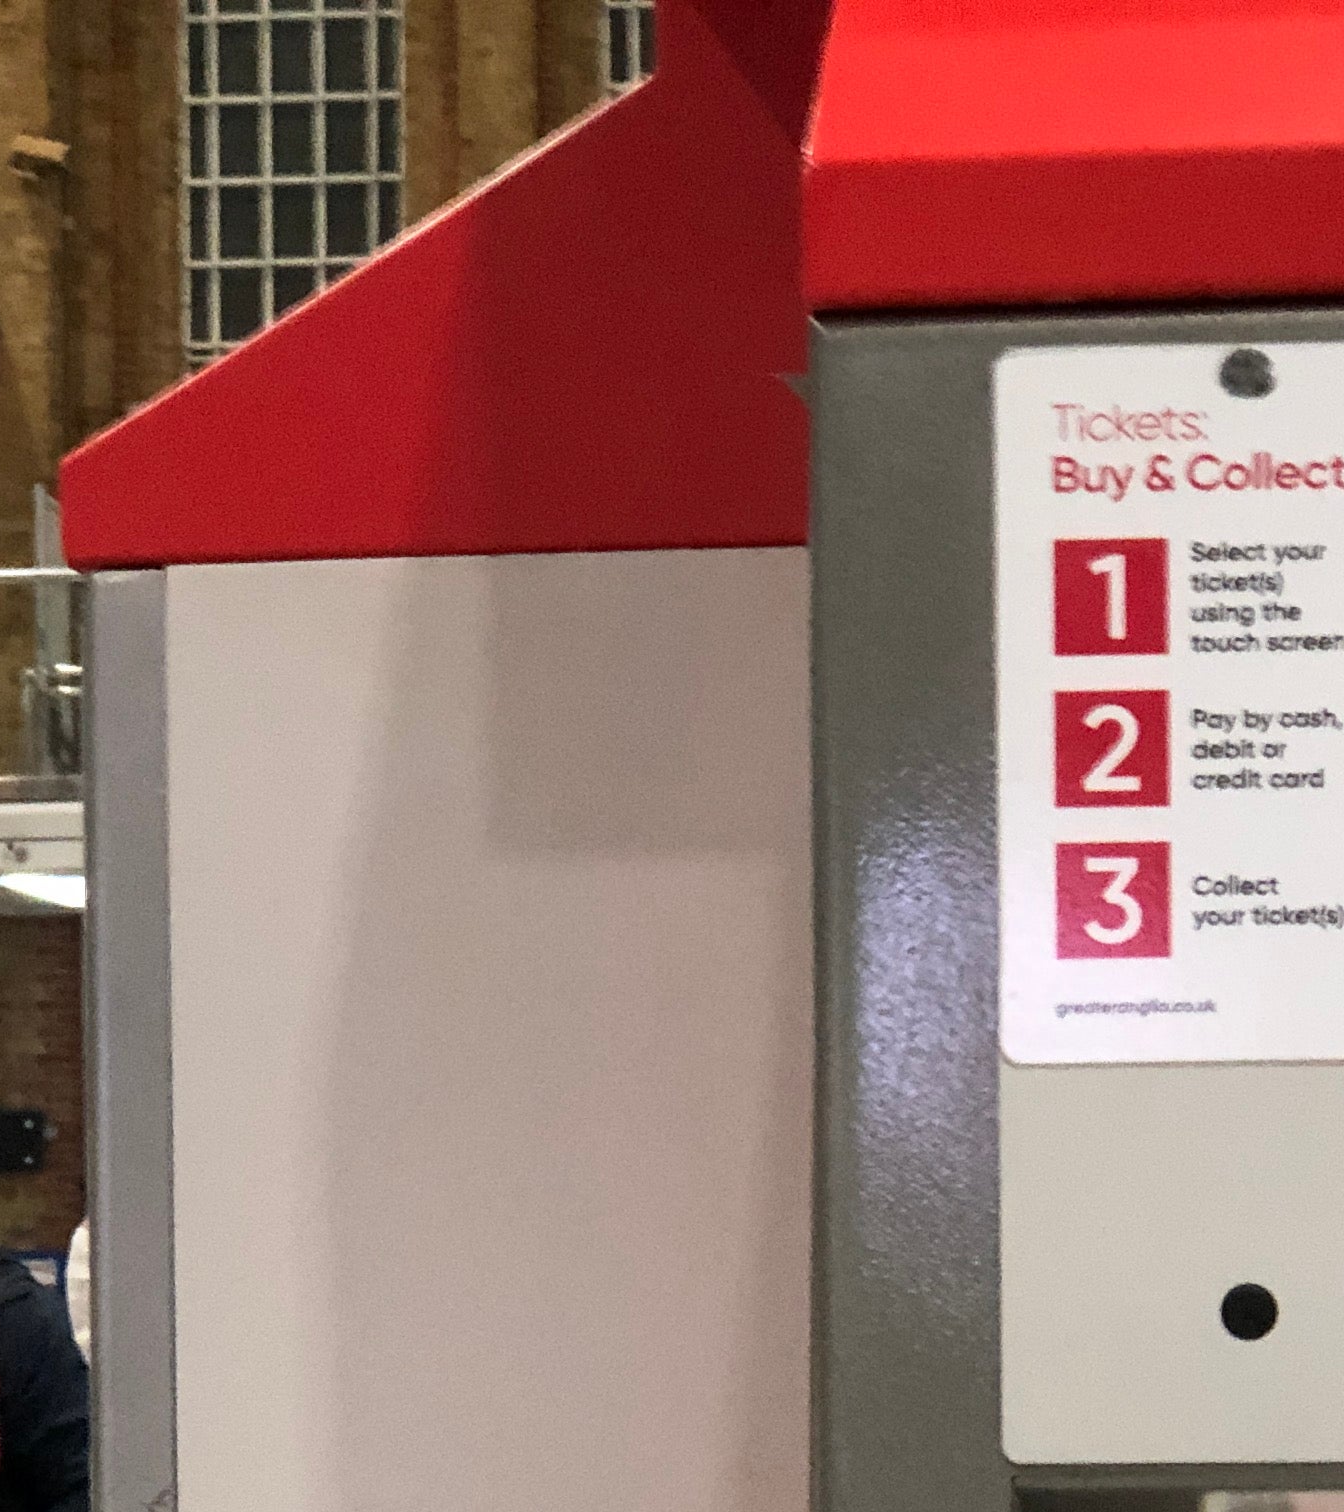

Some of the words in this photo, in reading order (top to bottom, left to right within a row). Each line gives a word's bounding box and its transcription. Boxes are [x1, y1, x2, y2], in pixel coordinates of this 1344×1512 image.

[1052, 402, 1209, 442] Tickets:
[1051, 454, 1134, 501] Buy
[1143, 453, 1176, 492] &
[1189, 541, 1266, 562] Select
[1275, 543, 1326, 565] your
[1190, 572, 1284, 596] ticket(s)
[1087, 552, 1128, 641] 1
[1190, 604, 1255, 626] using
[1261, 602, 1302, 622] the
[1190, 632, 1260, 653] touch
[1191, 709, 1235, 731] Pay
[1243, 708, 1270, 732] by
[1279, 709, 1344, 730] cash,
[1083, 703, 1141, 793] 2
[1191, 738, 1254, 760] debit
[1262, 743, 1287, 760] or
[1191, 770, 1262, 790] credit
[1269, 769, 1325, 790] card
[1191, 875, 1280, 896] Collect
[1083, 856, 1143, 945] 3
[1191, 907, 1245, 931] your
[1055, 998, 1217, 1019] greateranglia.co.uk
